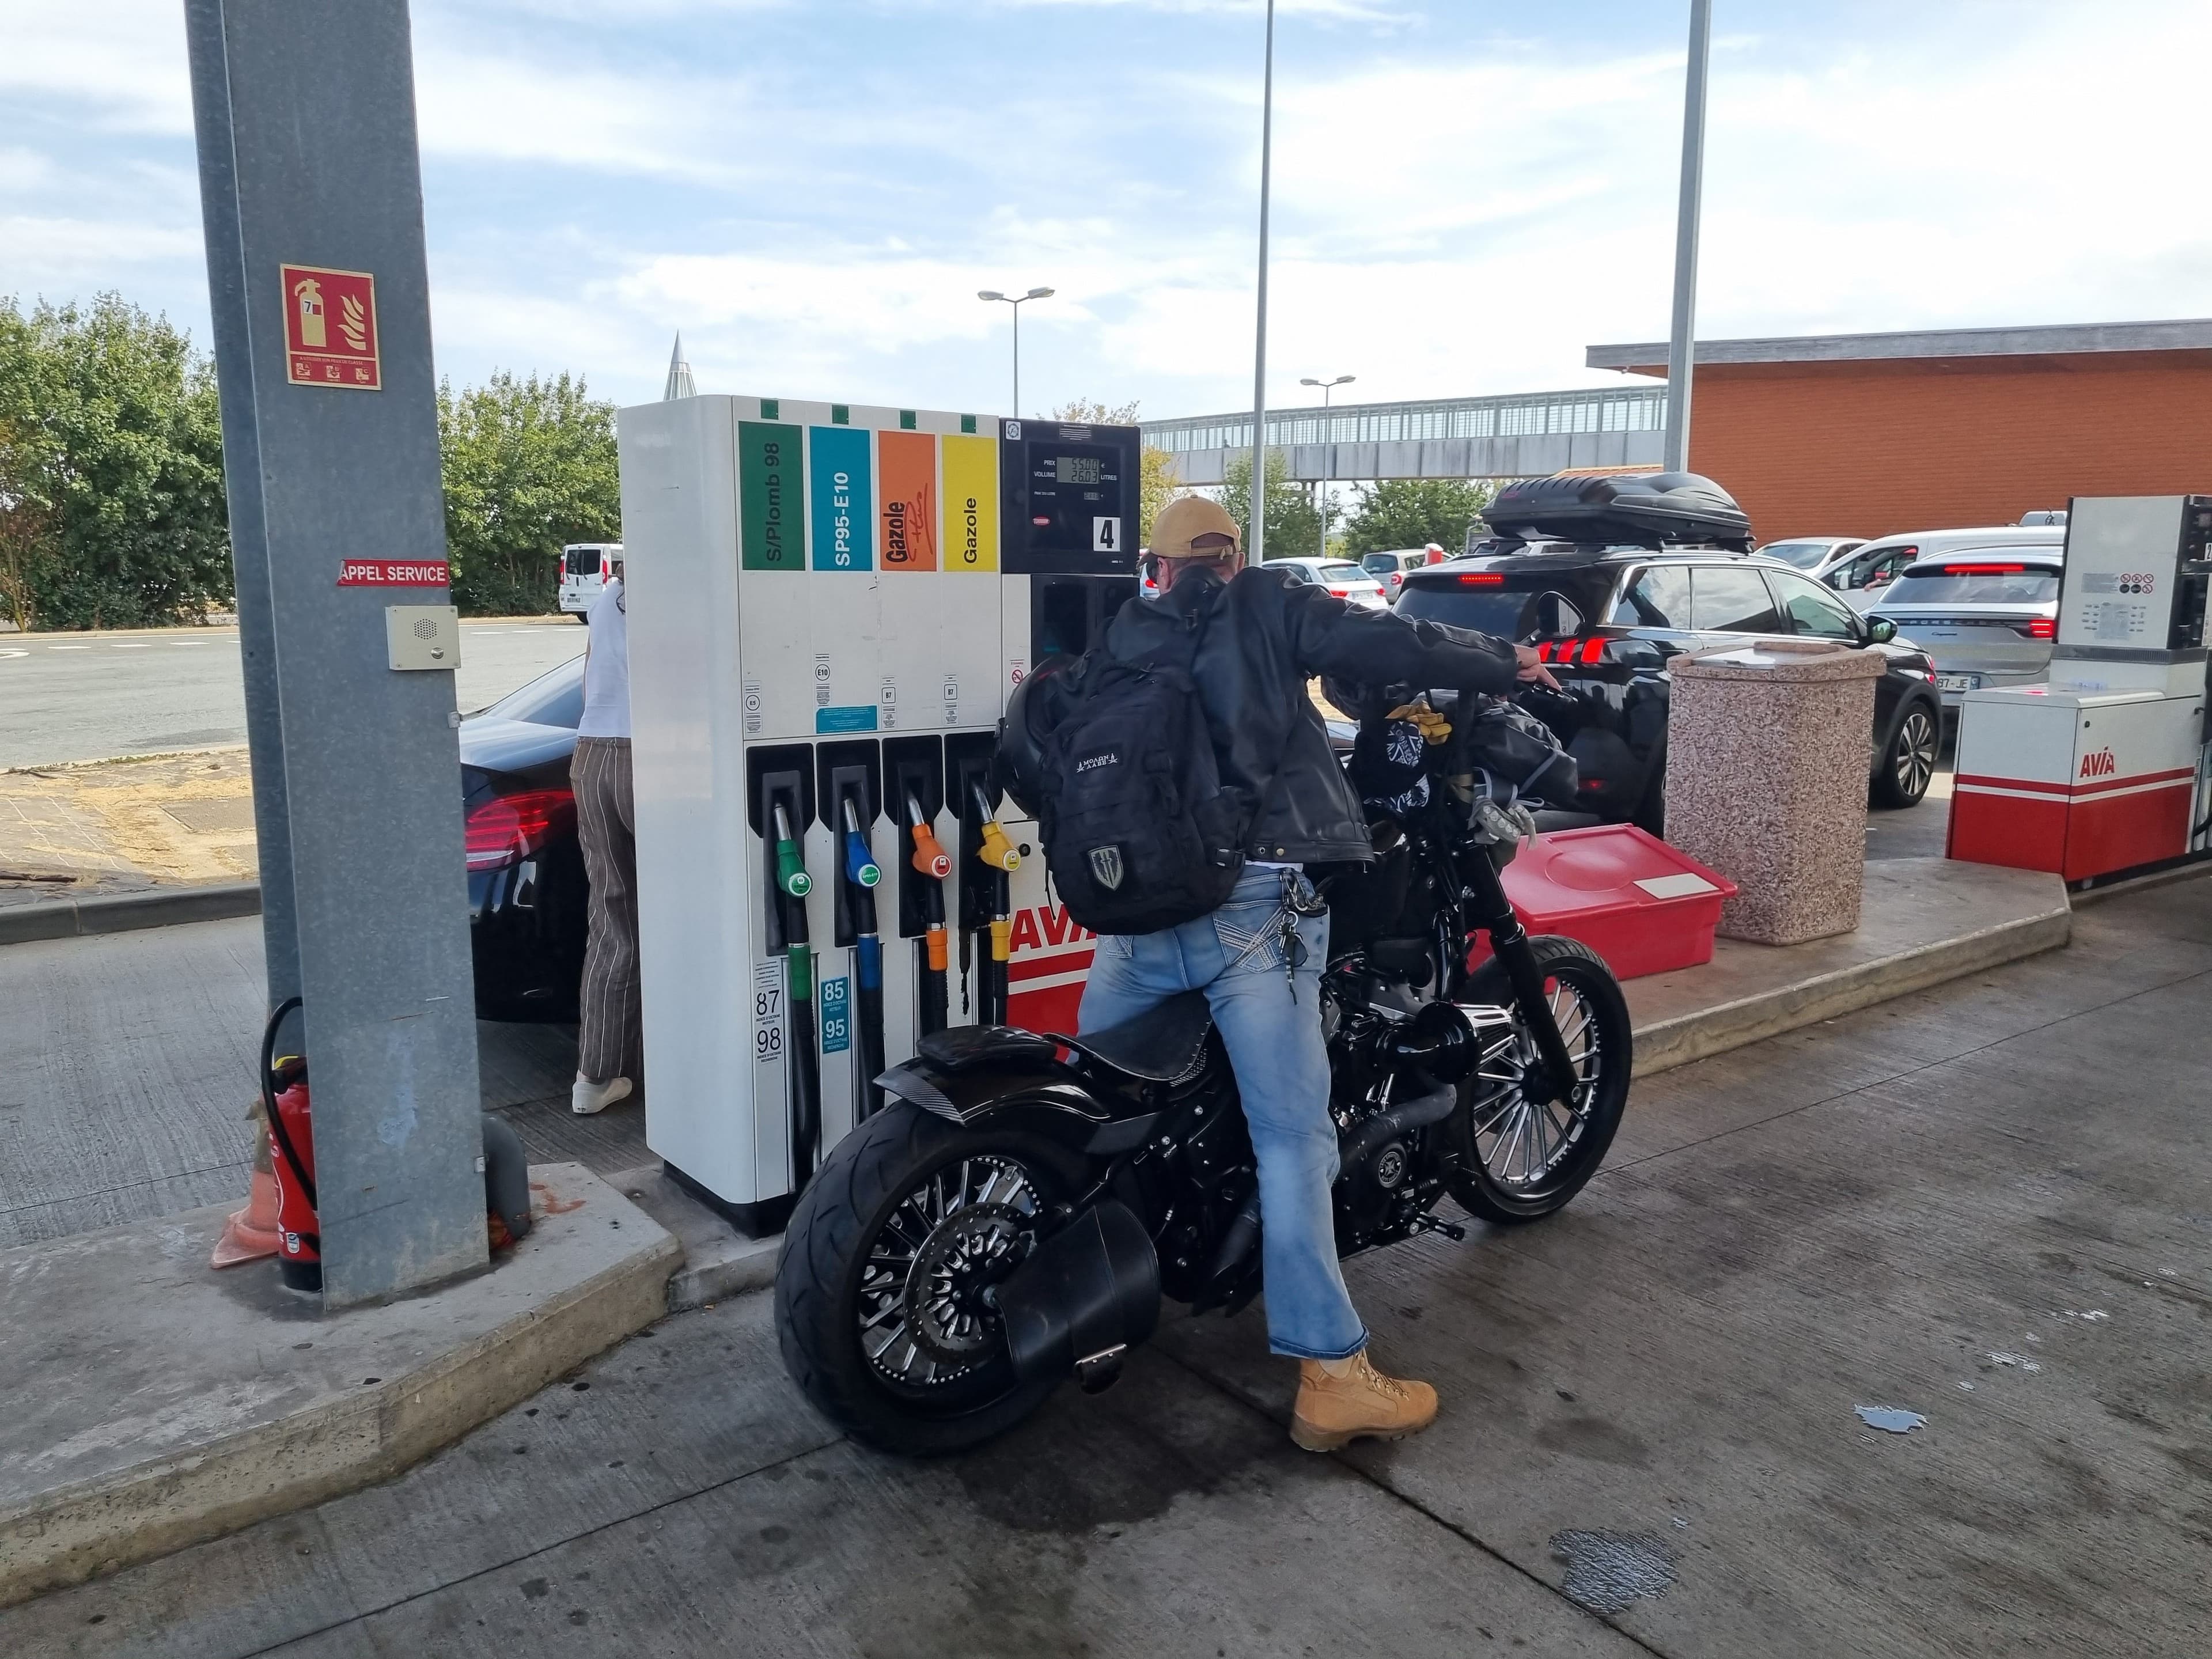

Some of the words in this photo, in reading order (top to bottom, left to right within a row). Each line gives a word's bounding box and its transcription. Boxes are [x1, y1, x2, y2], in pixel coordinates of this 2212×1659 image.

[304, 301, 311, 312] 7
[764, 442, 780, 467] 98
[765, 474, 782, 562] S/Plomb
[834, 472, 851, 567] SP95-E10
[964, 498, 977, 563] Gazole
[883, 502, 908, 563] Gazole
[1100, 520, 1114, 549] 4
[387, 566, 446, 582] SERVICE
[1010, 904, 1097, 953] AV
[756, 989, 779, 1016] 87
[824, 981, 844, 1001] 85
[757, 1027, 781, 1054] 98
[825, 1018, 844, 1039] 95
